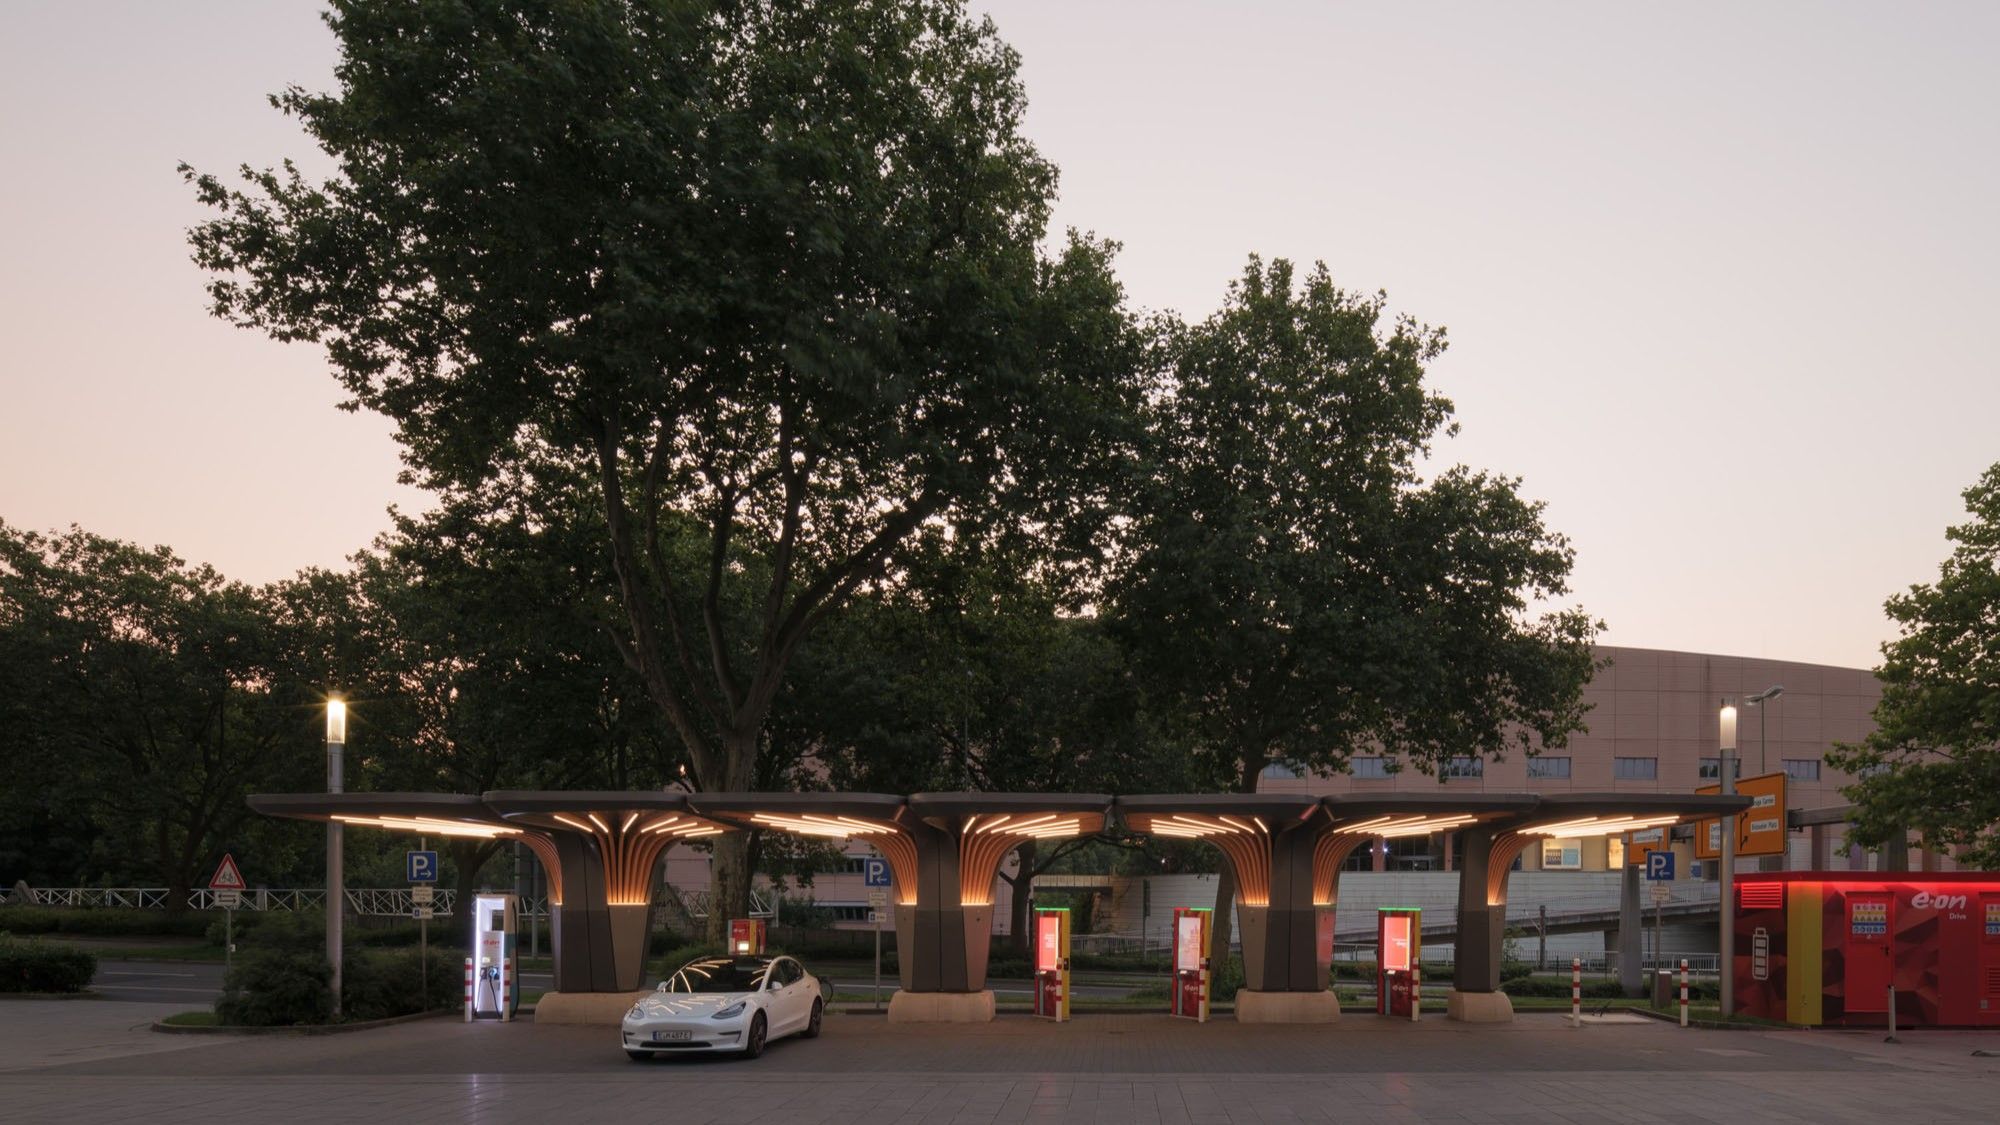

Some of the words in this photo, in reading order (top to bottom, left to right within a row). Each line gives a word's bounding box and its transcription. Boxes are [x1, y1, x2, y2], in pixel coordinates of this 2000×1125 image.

[413, 856, 429, 878] P
[869, 862, 884, 883] P
[1651, 855, 1666, 877] P
